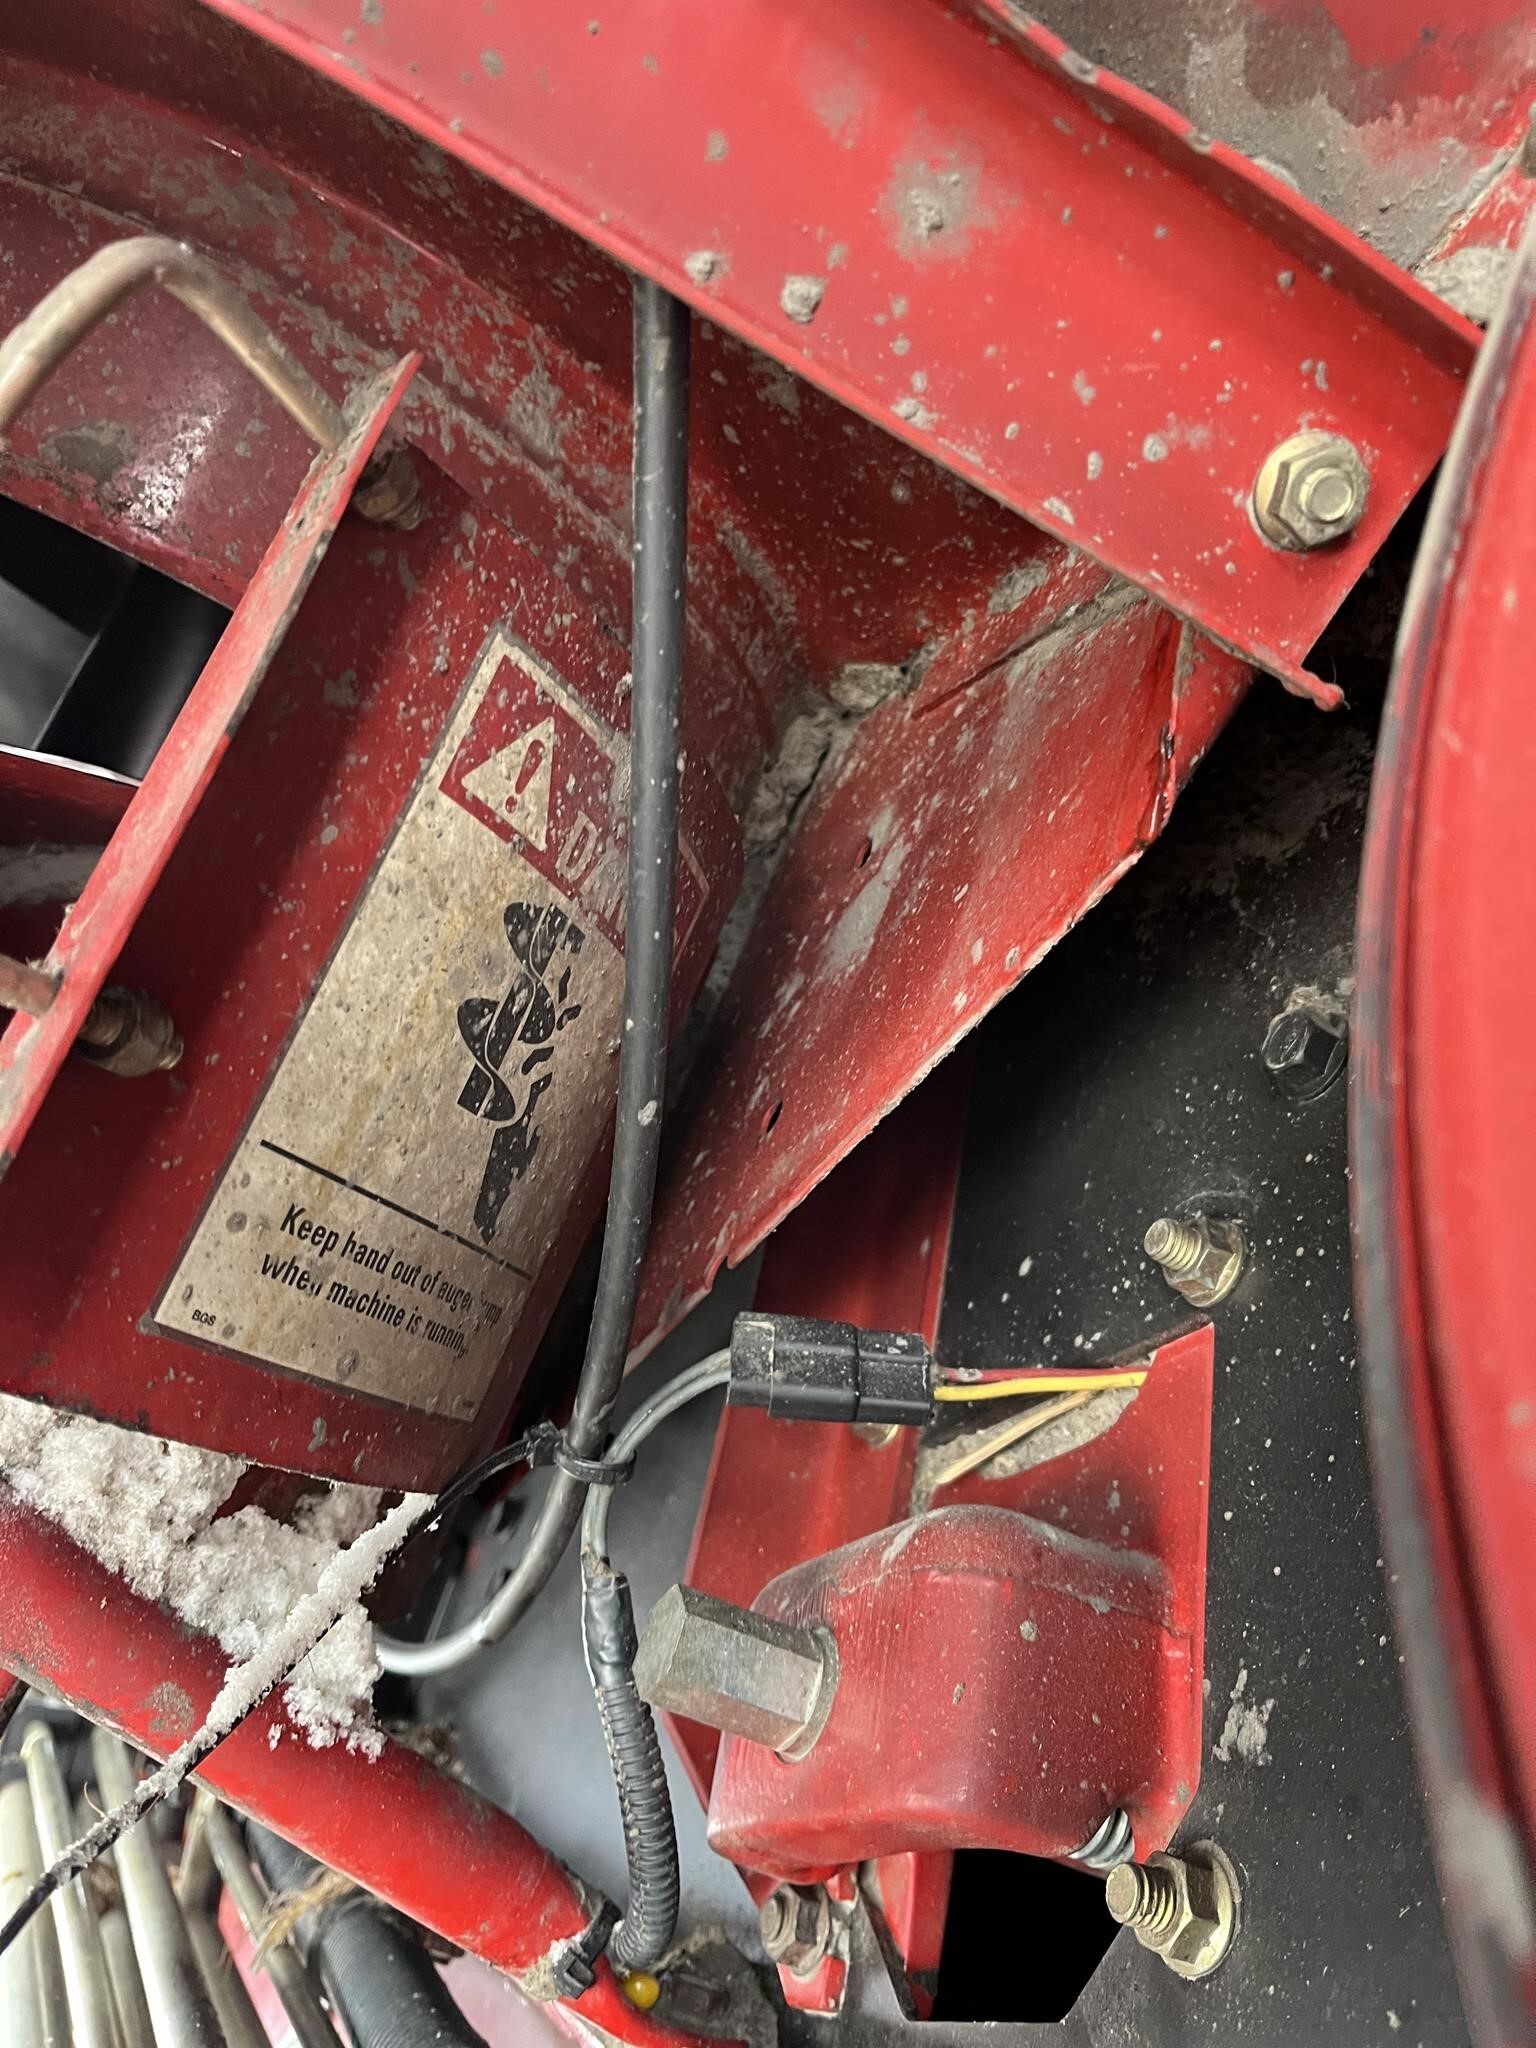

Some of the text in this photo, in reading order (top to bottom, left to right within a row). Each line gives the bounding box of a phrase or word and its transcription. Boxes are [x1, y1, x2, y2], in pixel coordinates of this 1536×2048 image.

[280, 1203, 340, 1258] Keep
[341, 1230, 395, 1274] hand
[391, 1261, 423, 1288] out
[420, 1270, 442, 1295] of
[326, 1281, 406, 1327] machine
[405, 1306, 422, 1335] is
